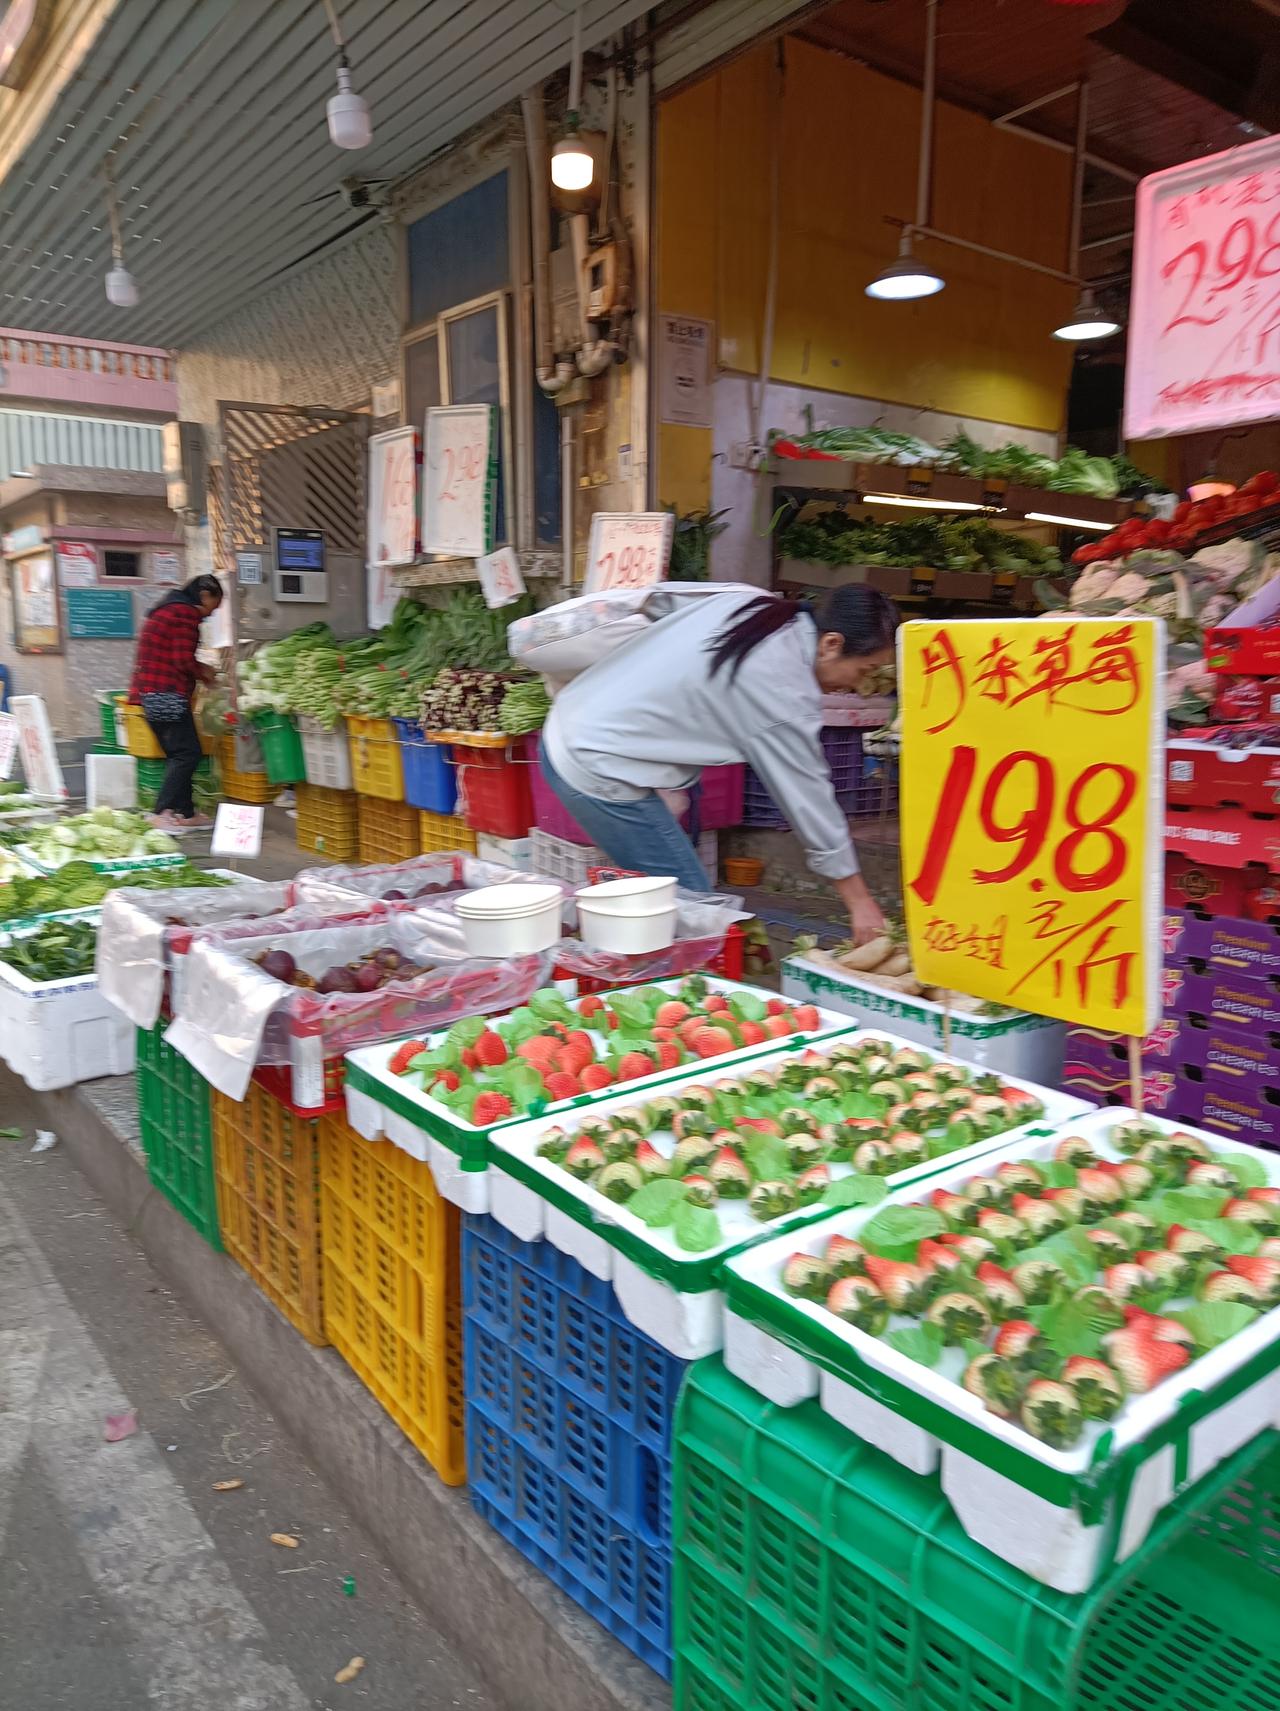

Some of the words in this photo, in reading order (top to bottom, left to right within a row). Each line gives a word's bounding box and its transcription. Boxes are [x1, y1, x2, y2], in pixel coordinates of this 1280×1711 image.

[921, 624, 1140, 735] 丹东草莓
[909, 744, 1139, 906] 19.8
